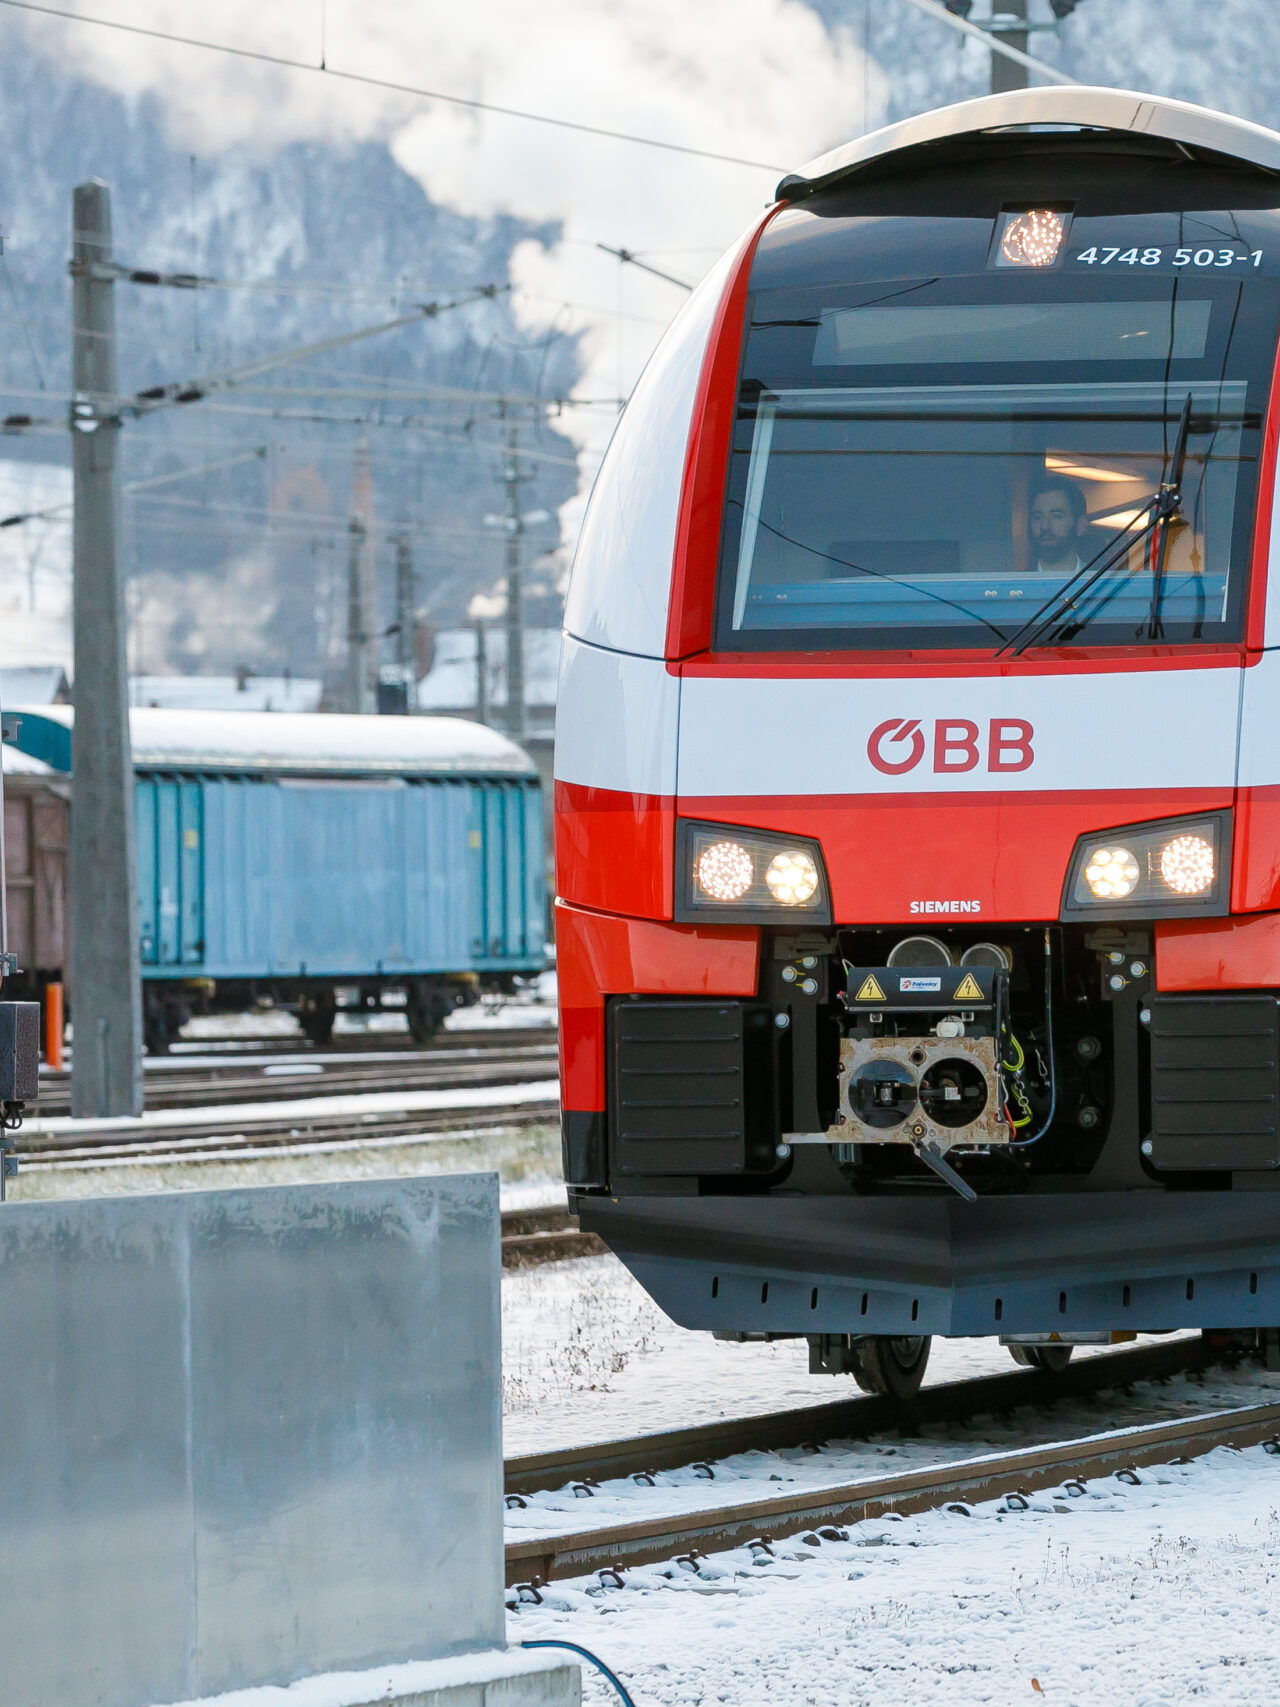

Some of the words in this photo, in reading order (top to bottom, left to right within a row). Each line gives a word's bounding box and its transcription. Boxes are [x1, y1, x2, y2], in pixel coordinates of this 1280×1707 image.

[1076, 246, 1161, 266] 4748
[1171, 248, 1264, 268] 503-1
[867, 717, 1035, 776] ÖBB
[909, 900, 981, 914] SIEMENS
